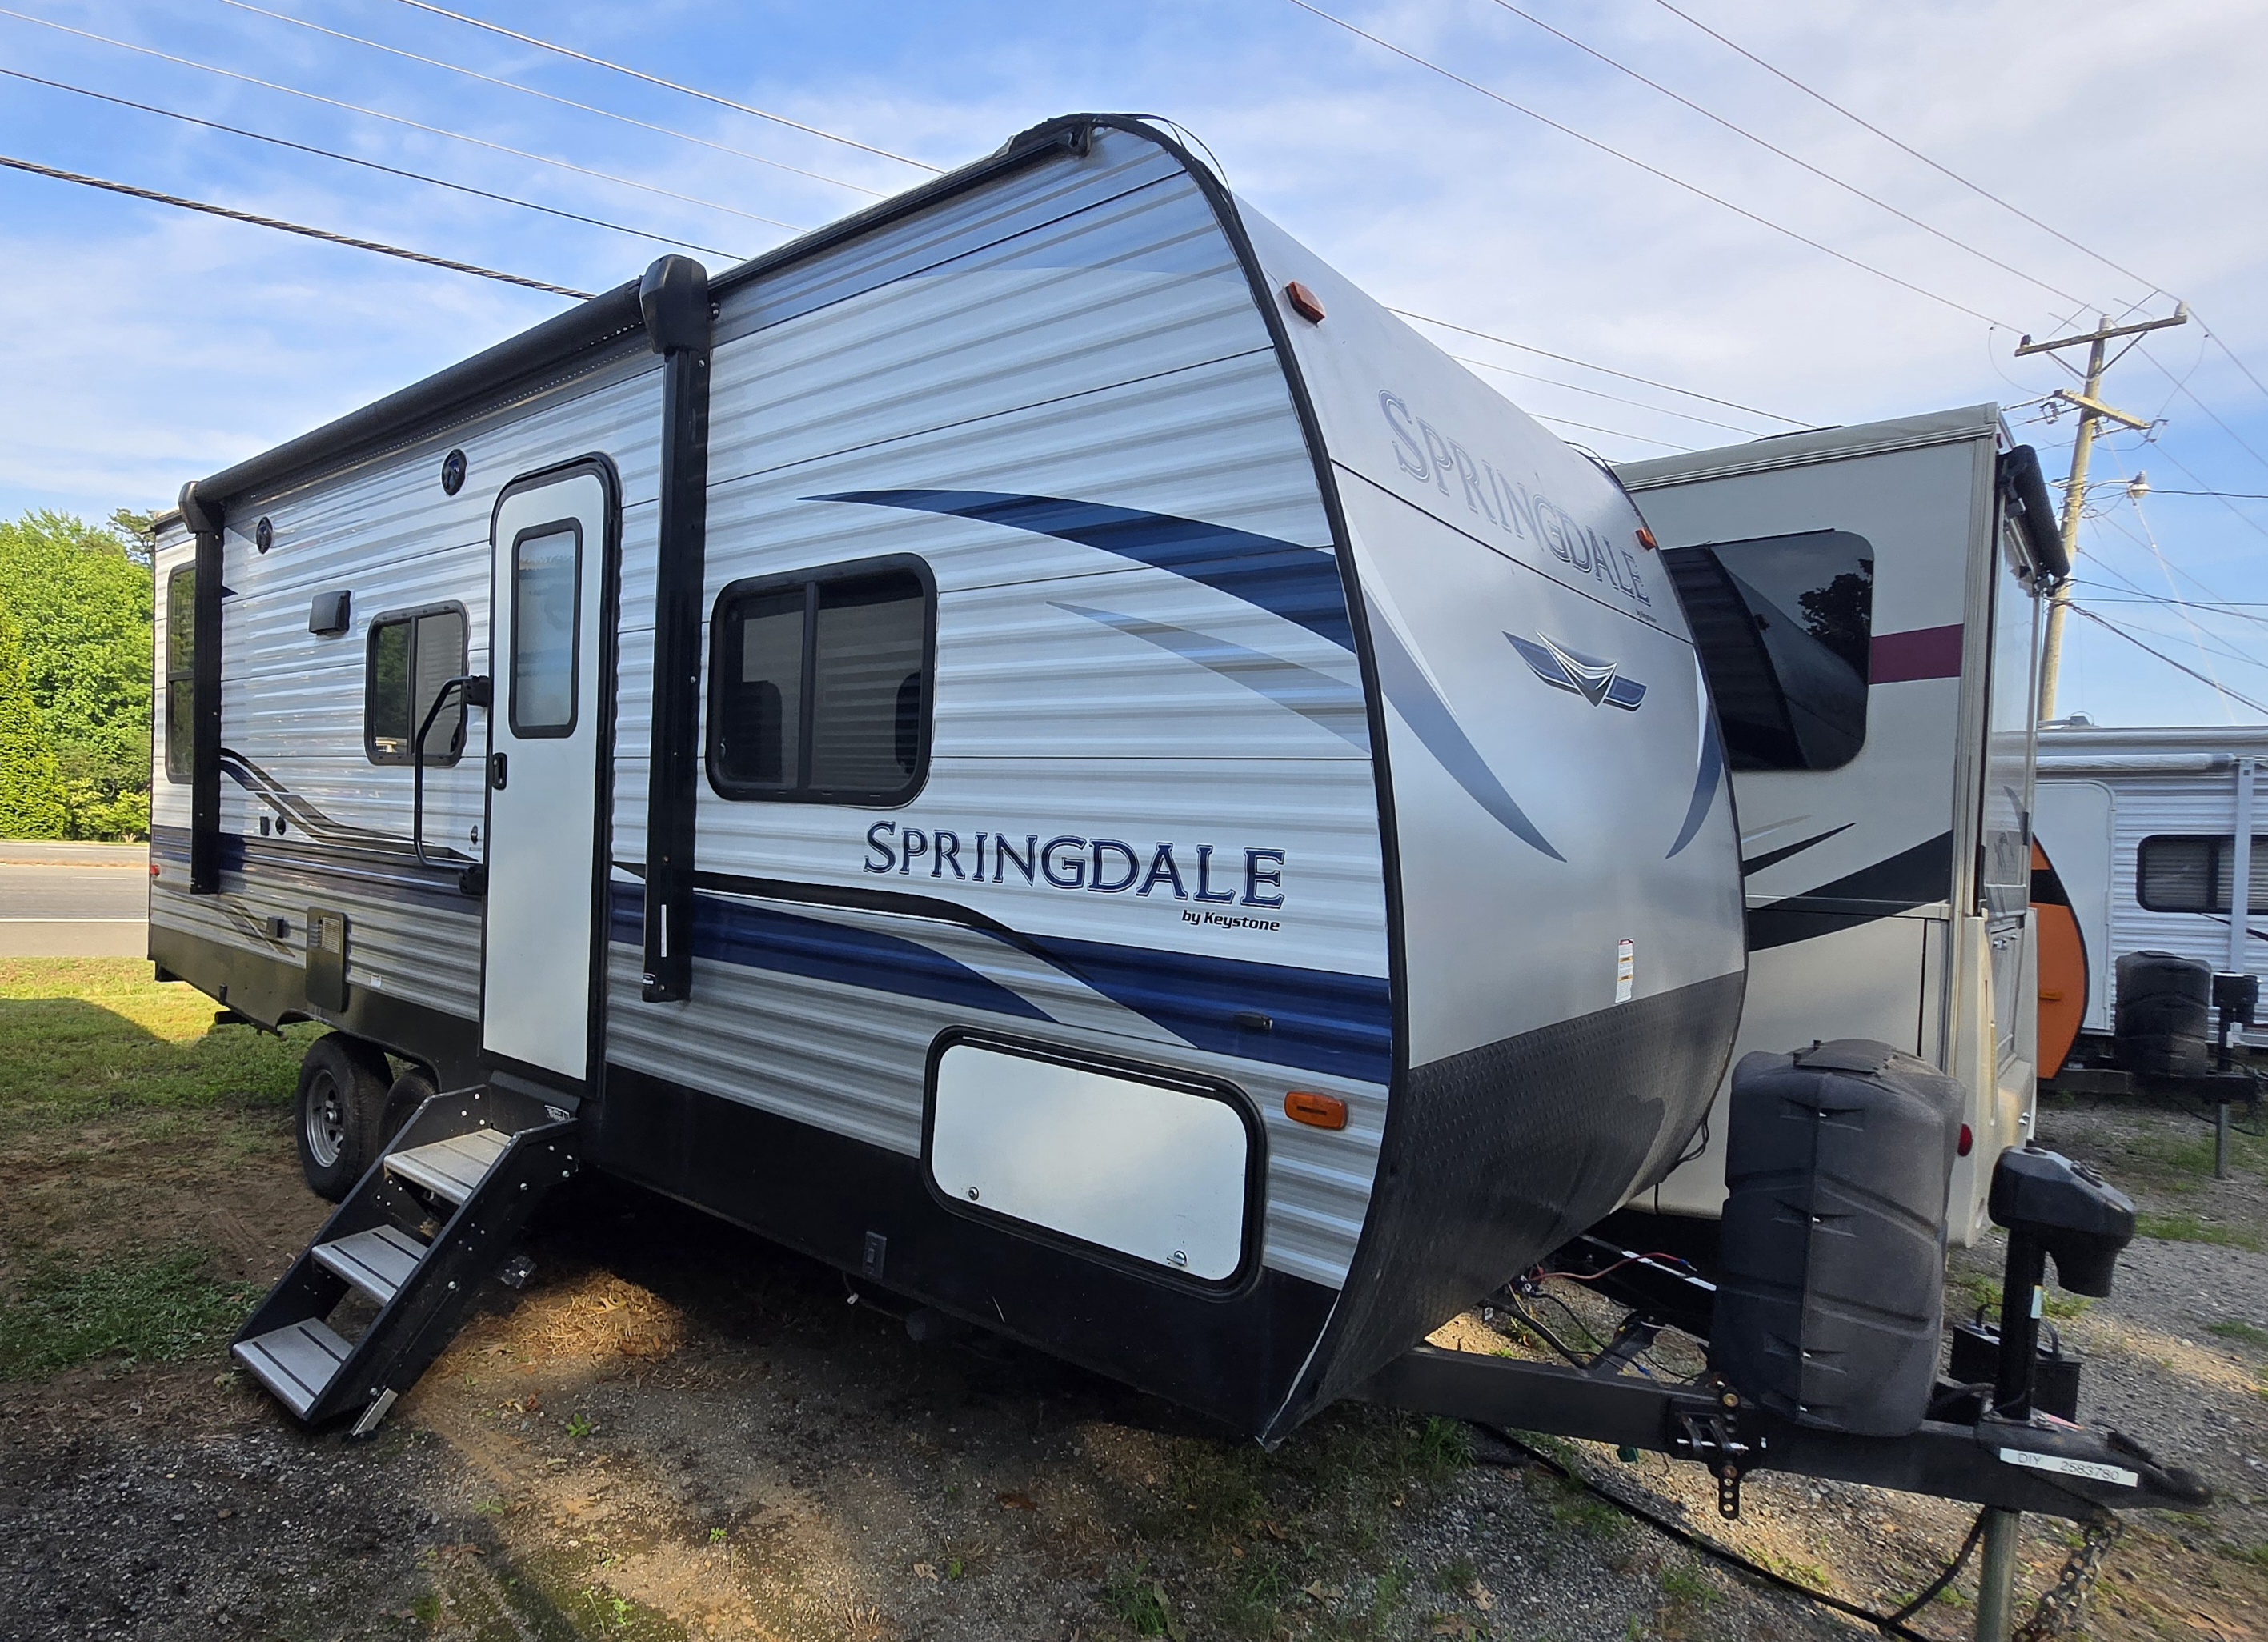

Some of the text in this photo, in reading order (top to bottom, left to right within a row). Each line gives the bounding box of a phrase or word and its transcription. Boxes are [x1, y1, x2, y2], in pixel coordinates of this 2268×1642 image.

[1378, 389, 1652, 607] SPRINGDALE
[863, 820, 1286, 910] SPRINGDALE
[1181, 909, 1280, 931] by Keystone
[2018, 1452, 2120, 1481] DIY 2583780
